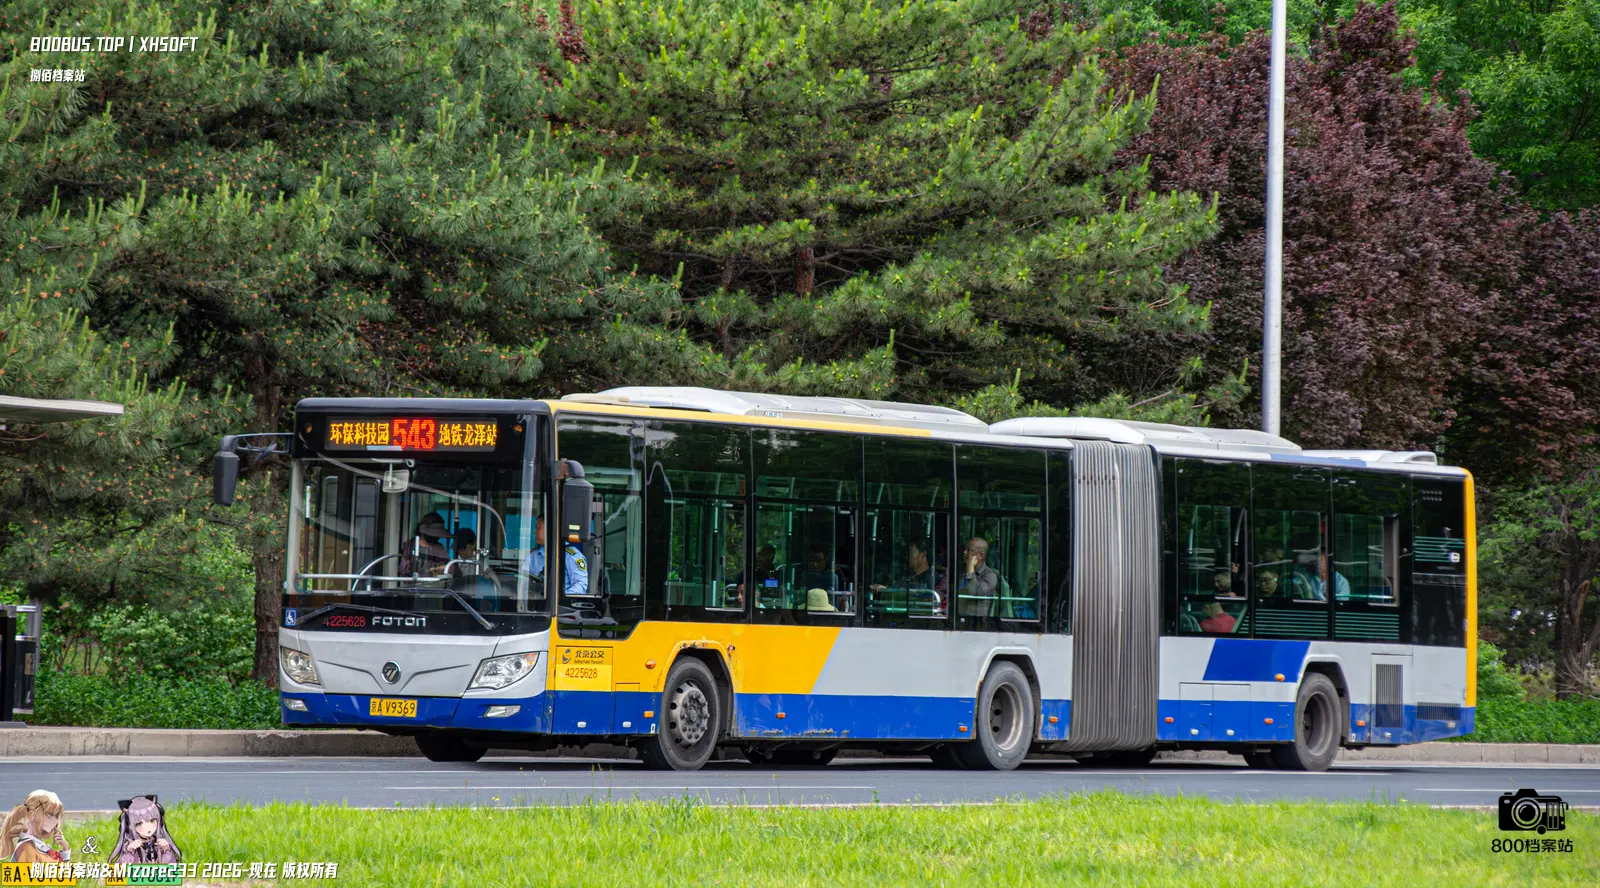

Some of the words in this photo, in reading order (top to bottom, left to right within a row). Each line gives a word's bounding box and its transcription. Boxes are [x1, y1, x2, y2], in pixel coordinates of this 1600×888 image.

[330, 422, 389, 445] 环保科技园
[392, 419, 436, 449] 543
[439, 423, 497, 446] 地铁龙泽站
[323, 615, 366, 627] 4225628
[372, 616, 426, 627] FOTON
[575, 650, 604, 658] 北京公交
[565, 668, 597, 678] 4225628
